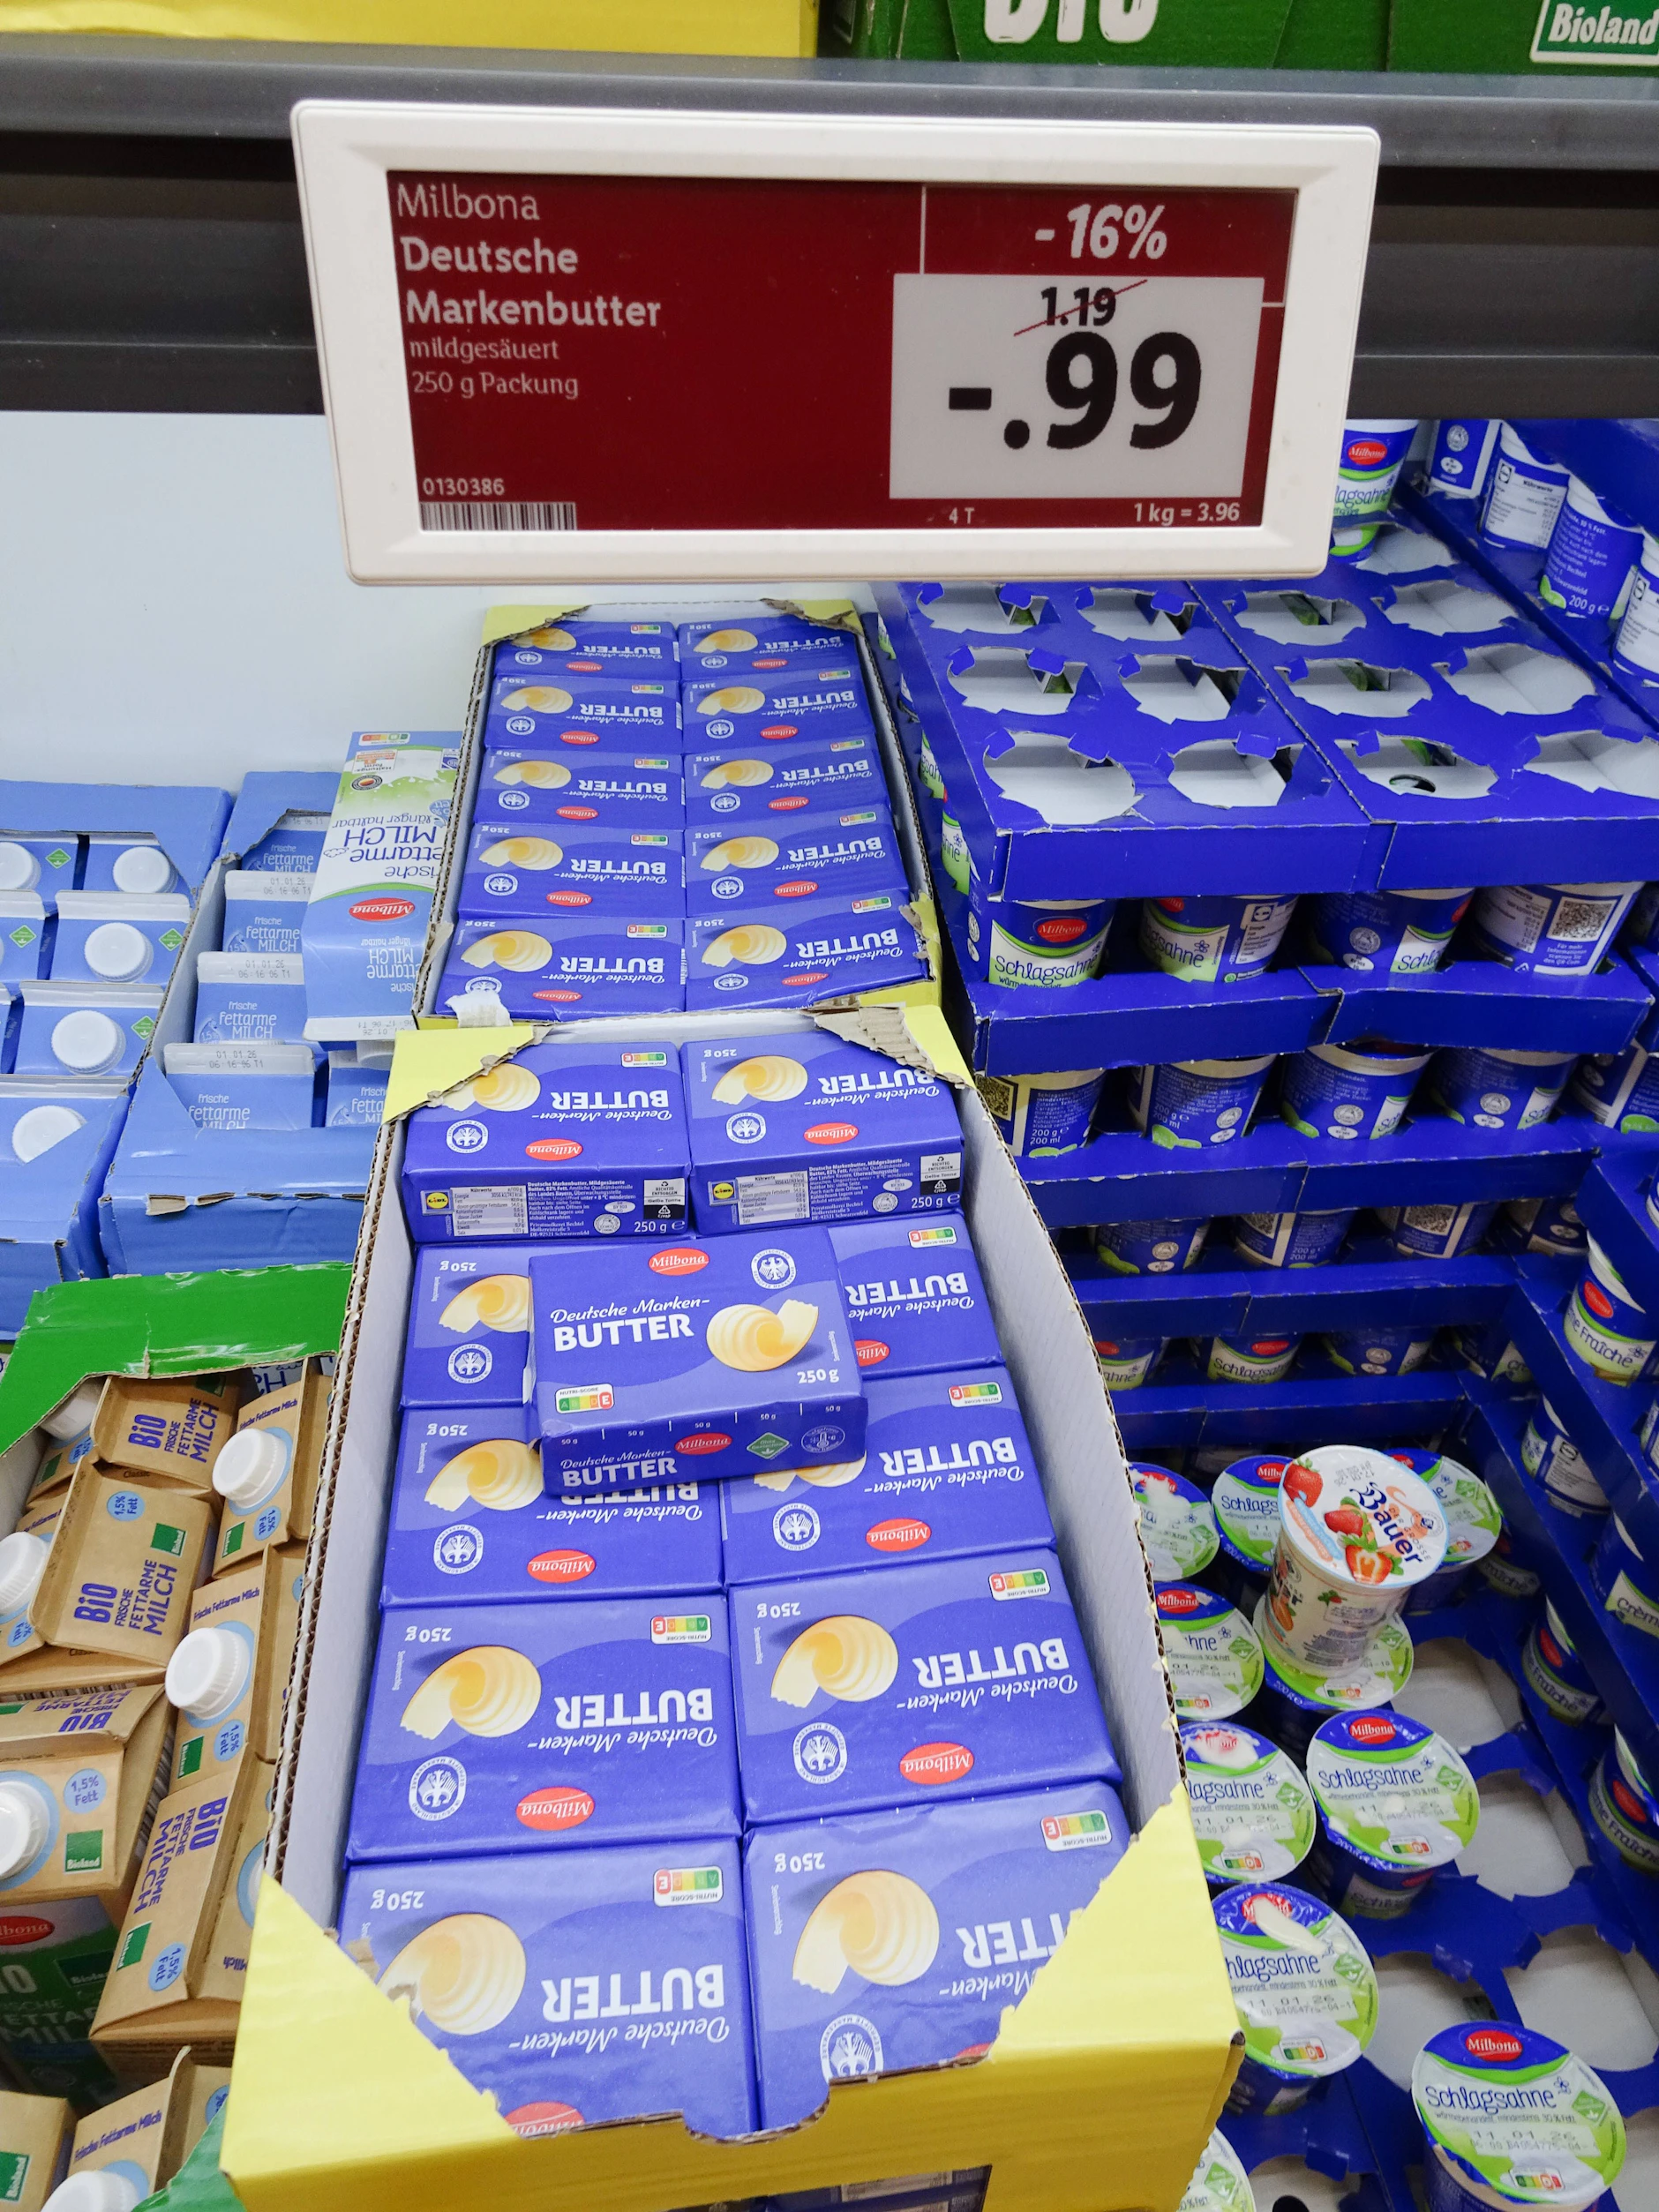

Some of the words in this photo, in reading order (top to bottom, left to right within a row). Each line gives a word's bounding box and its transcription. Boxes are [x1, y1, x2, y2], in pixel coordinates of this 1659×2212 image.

[1548, 2, 1657, 47] Bioland
[398, 182, 540, 221] Milbona
[400, 236, 578, 274] Deutsche
[406, 289, 661, 327] Markenbutter
[1040, 287, 1116, 326] 1.19
[409, 336, 559, 364] mildgesäuert
[412, 371, 454, 394] 250
[460, 375, 475, 399] g
[480, 371, 579, 401] Packung
[1348, 446, 1387, 459] Milbona
[423, 477, 505, 495] 0130386
[1335, 485, 1390, 506] lagsahne
[949, 506, 958, 524] 4
[965, 507, 976, 524] T
[1134, 503, 1142, 522] 1
[1149, 503, 1175, 527] kg
[1197, 502, 1241, 522] 3.96
[1568, 595, 1588, 610] 200
[771, 690, 855, 709] BUTTER
[579, 703, 663, 717] BUTTER
[780, 759, 869, 782] BUTTER
[577, 779, 667, 794] BUTTER
[332, 815, 383, 829] haltbar
[387, 813, 432, 825] länger
[344, 826, 437, 848] MILCH
[263, 852, 314, 866] fettarme
[349, 846, 443, 862] ettarme
[787, 836, 882, 862] BUTTER
[384, 866, 440, 879] rische
[570, 859, 666, 875] BUTTER
[351, 904, 415, 915] Milbona
[254, 916, 282, 926] frische
[1039, 923, 1086, 936] Milbona
[245, 926, 301, 940] fettarme
[258, 939, 297, 952] MILCH
[795, 928, 898, 959] BUTTER
[369, 949, 414, 964] MILCH
[559, 956, 664, 974] BUTTER
[995, 948, 1100, 985] Schlagsahne
[228, 1001, 258, 1010] frische
[219, 1011, 277, 1026] fettarme
[232, 1026, 274, 1039] MILCH
[817, 1069, 935, 1095] BUTTER
[198, 1093, 229, 1104] frische
[550, 1090, 669, 1111] BUTTER
[804, 1092, 871, 1107] Marken-
[874, 1085, 940, 1102] Deutsche
[188, 1106, 251, 1121] fettarme
[531, 1110, 602, 1123] Marken-
[604, 1109, 672, 1122] Deutsche
[806, 1128, 857, 1140] Milbona
[1031, 1136, 1048, 1146] 200
[1032, 1128, 1049, 1138] 200
[529, 1144, 581, 1155] Milbona
[911, 1196, 933, 1209] 250
[935, 1197, 943, 1208] g
[634, 1220, 657, 1233] 250
[659, 1222, 667, 1233] g
[649, 1255, 706, 1268] Milbona
[845, 1272, 969, 1306] BUTTER
[550, 1302, 627, 1323] Deutsche
[632, 1295, 710, 1315] Marken-
[905, 1296, 974, 1315] Deutsche
[553, 1313, 694, 1352] BUTTER
[857, 1346, 888, 1360] Milb
[176, 1397, 202, 1456] FETTARME
[190, 1401, 220, 1463] MILCH
[676, 1436, 729, 1451] Milbona
[559, 1454, 615, 1470] Deutsche
[617, 1449, 672, 1462] Marken-
[880, 1436, 1018, 1477] BUTTER
[562, 1457, 678, 1488] BUTTER
[948, 1466, 1025, 1488] Deutsche
[864, 1476, 942, 1496] Marken-
[623, 1504, 702, 1526] Deutsche
[1221, 1495, 1280, 1516] Schlags
[536, 1506, 619, 1526] Marken-
[1349, 1481, 1423, 1563] Bauer
[869, 1525, 929, 1545] Milbona
[531, 1557, 593, 1574] Milbona
[129, 1559, 157, 1631] FETTARME
[143, 1563, 178, 1636] MILCH
[241, 1586, 260, 1604] Milch
[114, 1587, 134, 1627] FRISCHE
[912, 1638, 1070, 1688] BUTTER
[990, 1674, 1078, 1701] Deutsche
[554, 1688, 713, 1730] BUTTER
[897, 1687, 986, 1713] Marken-
[627, 1727, 718, 1752] Deutsche
[1350, 1722, 1395, 1738] Milbona
[528, 1730, 621, 1755] Marken-
[905, 1751, 972, 1773] Milbona
[71, 1775, 99, 1792] 1,5%
[1318, 1766, 1424, 1790] Schlagsahne
[74, 1791, 99, 1806] Fett
[1189, 1780, 1264, 1805] lagsahne
[520, 1799, 594, 1818] Milbona
[175, 1807, 197, 1856] FRISCHE
[67, 1856, 101, 1870] Bioland
[133, 1818, 173, 1916] MILCH
[149, 1812, 184, 1907] FETTARME
[956, 1913, 1068, 1969] TTER
[1225, 1953, 1321, 1983] hlagsahne
[540, 1964, 724, 2022] BUTTER
[509, 2024, 619, 2058] Marken-
[625, 2015, 731, 2050] Deutsche
[1468, 2037, 1520, 2053] Milbona
[1424, 2085, 1558, 2115] Schlagsahne
